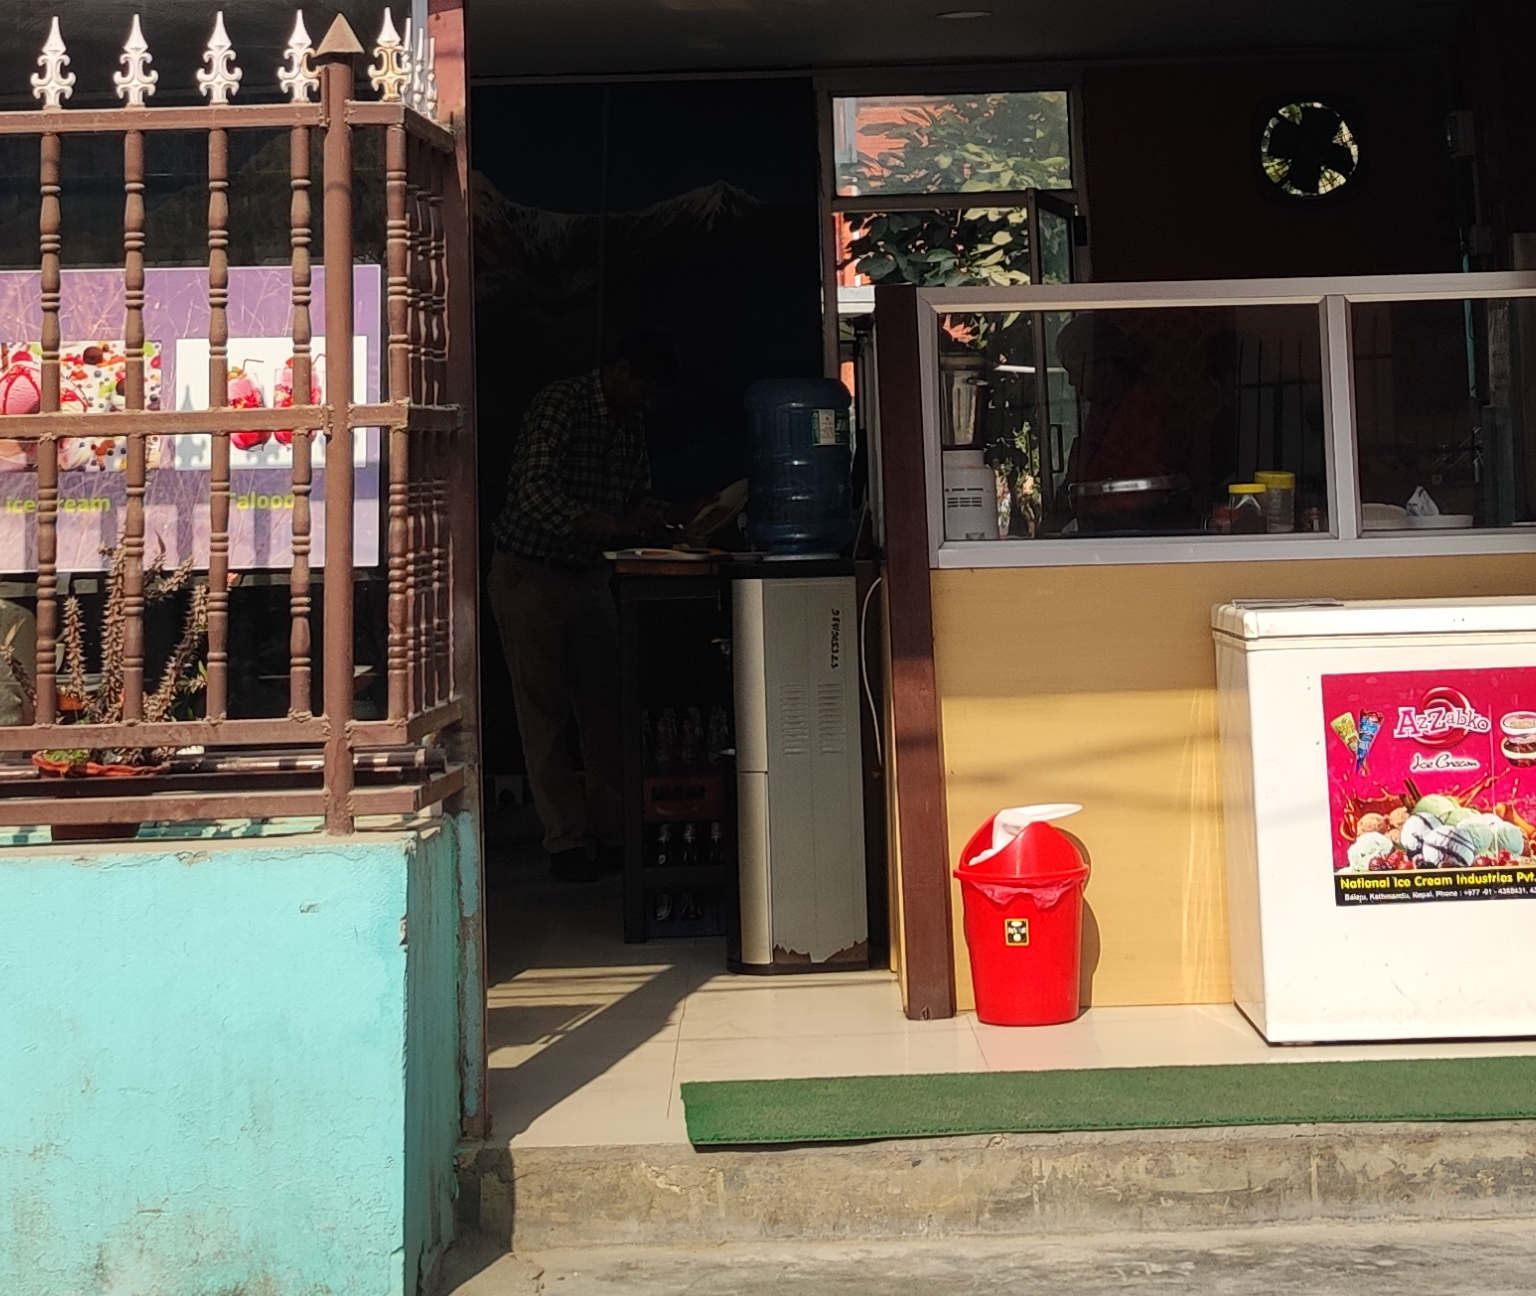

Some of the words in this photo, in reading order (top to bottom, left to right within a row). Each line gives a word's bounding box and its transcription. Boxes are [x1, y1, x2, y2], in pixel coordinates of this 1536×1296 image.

[57, 495, 112, 514] ream
[1340, 875, 1391, 890] National
[1414, 874, 1453, 888] Cream
[1456, 872, 1514, 886] Industries
